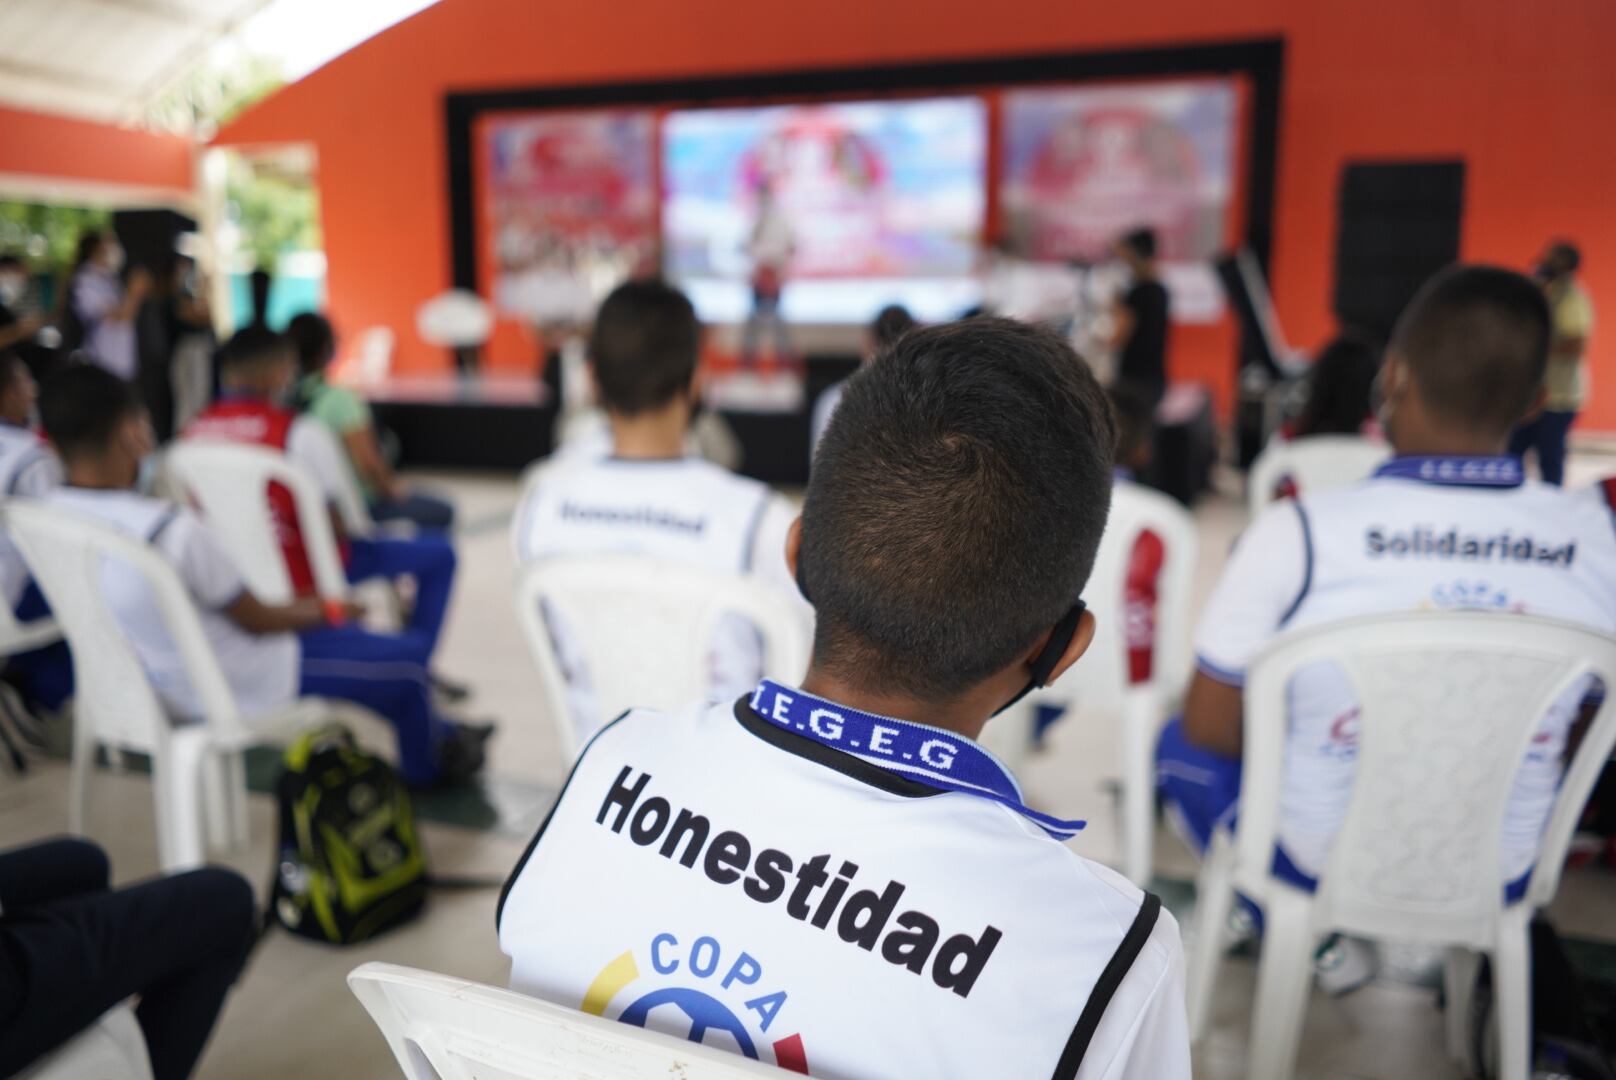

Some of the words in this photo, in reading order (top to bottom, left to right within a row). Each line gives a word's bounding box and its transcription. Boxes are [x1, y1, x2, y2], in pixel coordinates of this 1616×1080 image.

[1366, 526, 1577, 568] Solidaridad
[749, 684, 958, 769] I.E.G.E.G
[596, 765, 1003, 998] Honestidad
[651, 932, 789, 1033] COPA
